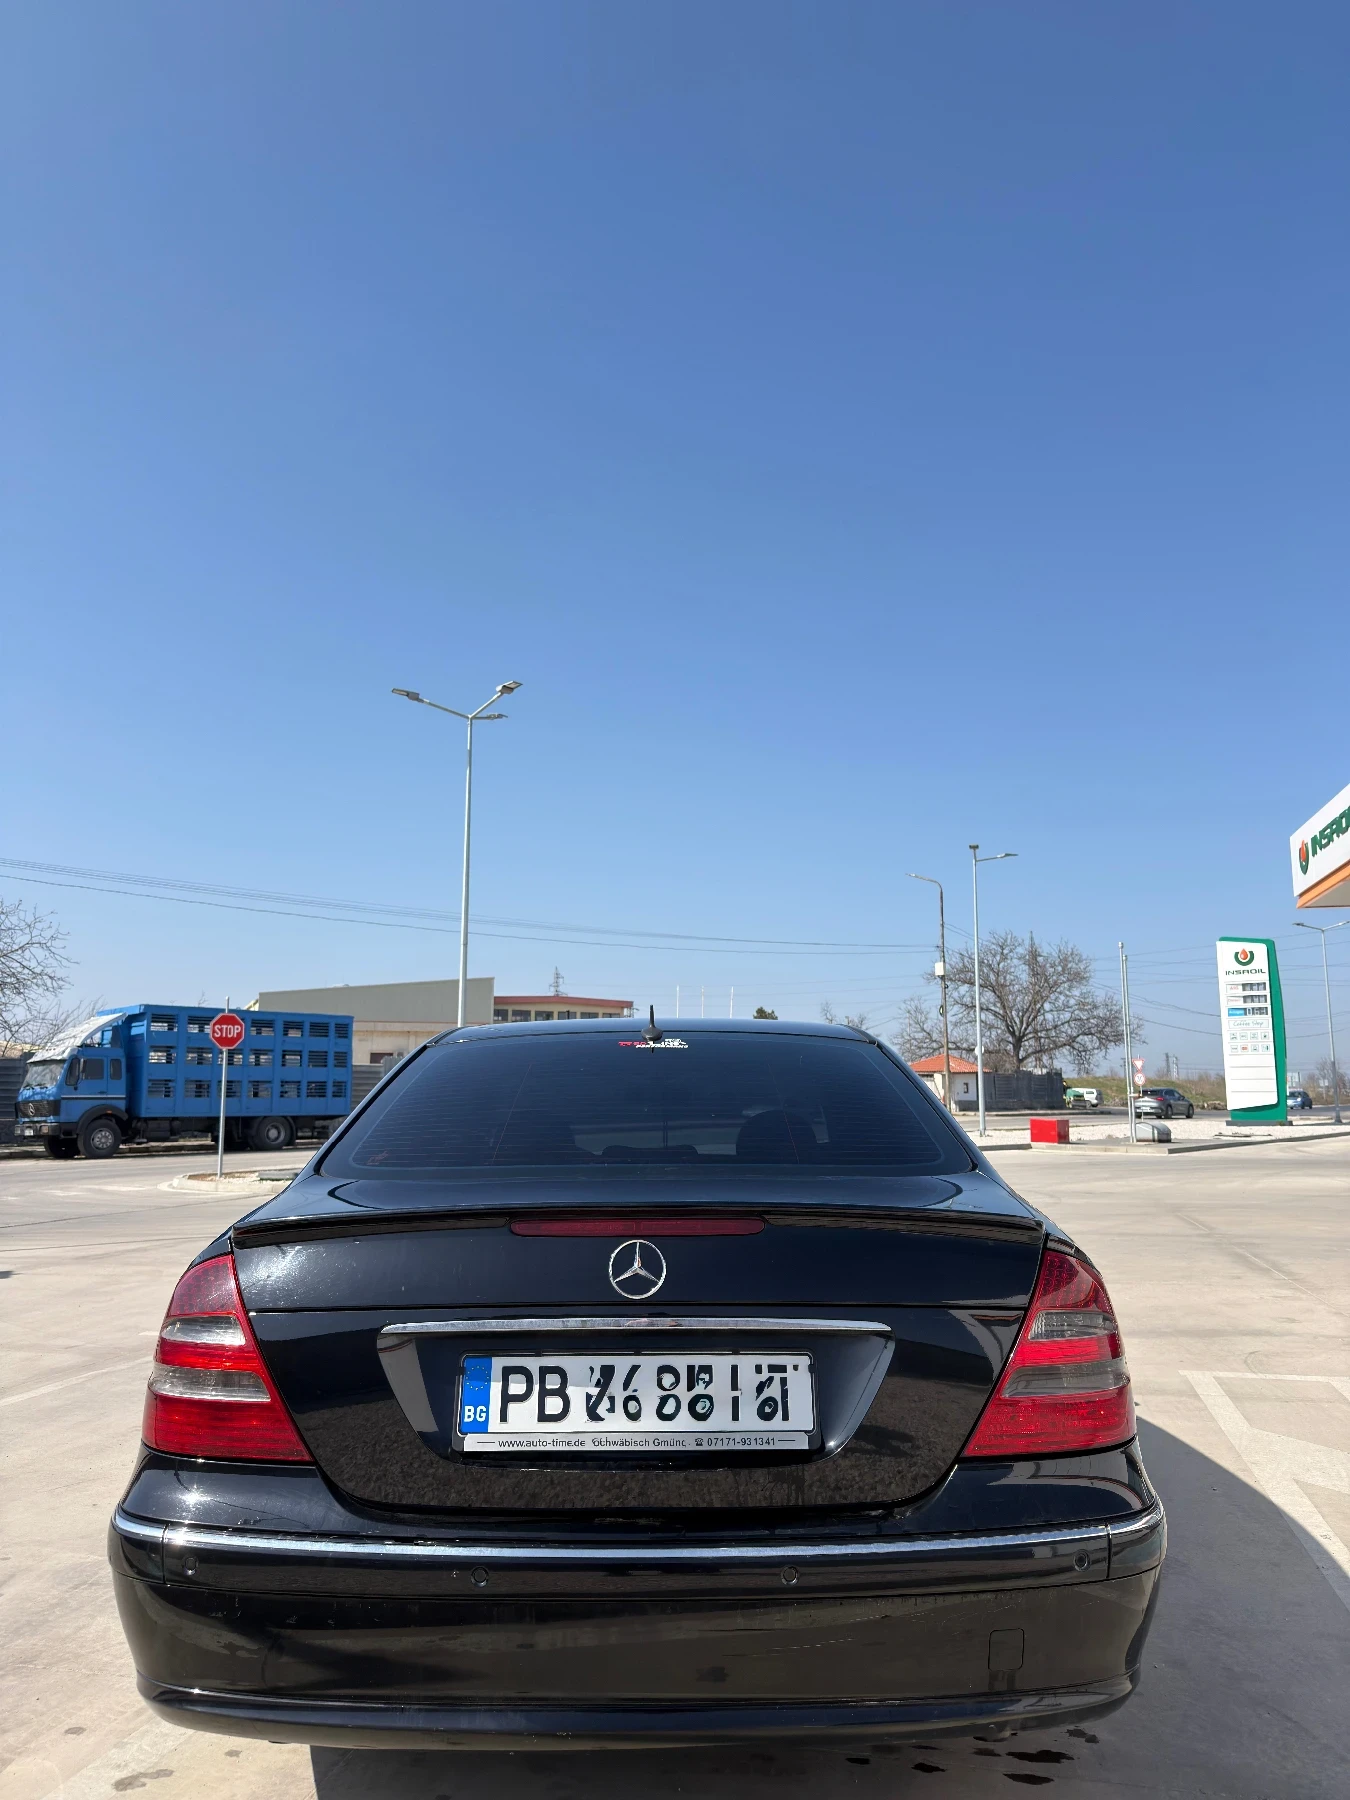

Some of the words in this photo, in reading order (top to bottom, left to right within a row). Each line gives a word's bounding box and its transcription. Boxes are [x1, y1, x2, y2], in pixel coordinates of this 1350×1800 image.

[214, 1024, 241, 1038] STOP
[464, 1405, 487, 1422] BG
[498, 1438, 586, 1448] www.auto-time.de
[707, 1437, 775, 1447] 07171-931341
